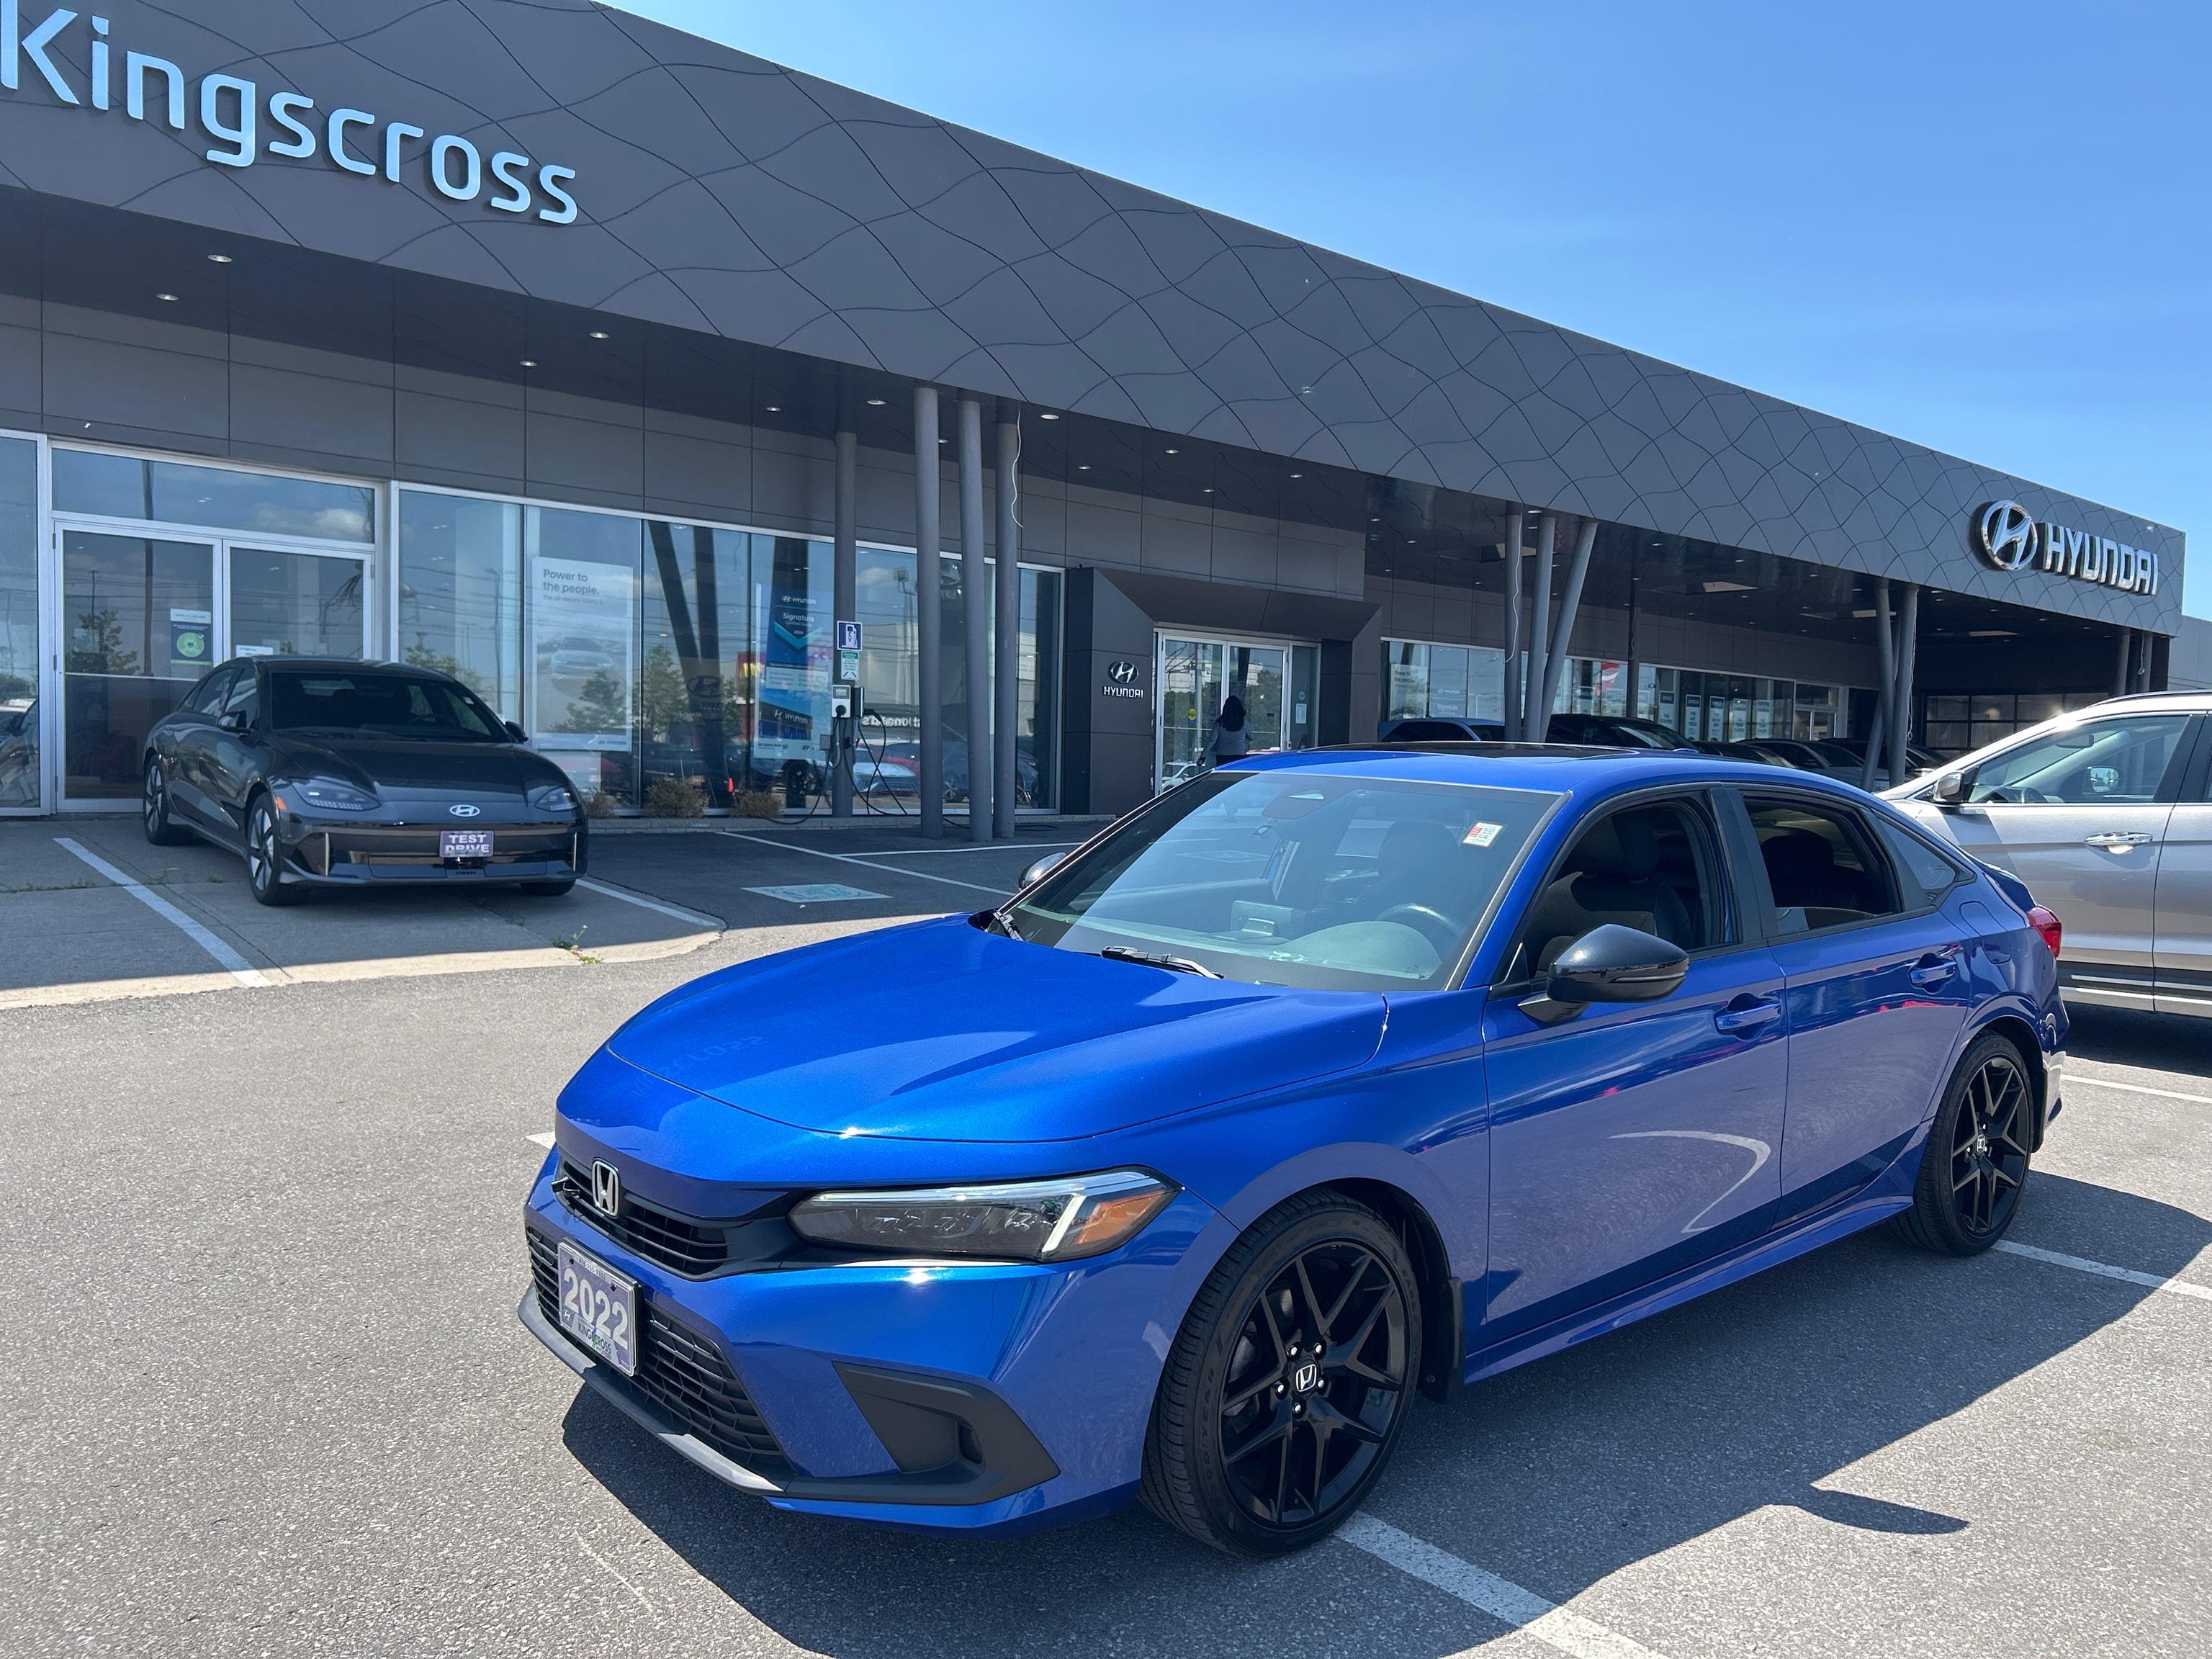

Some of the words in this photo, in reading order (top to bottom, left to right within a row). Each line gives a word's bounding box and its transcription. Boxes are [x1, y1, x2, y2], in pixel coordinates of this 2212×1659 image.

[0, 0, 578, 225] Kingscross
[2044, 522, 2159, 595] HYUNDAI
[544, 569, 575, 580] Power
[577, 573, 588, 582] to
[544, 582, 559, 591] the
[562, 585, 600, 595] people.
[783, 613, 815, 623] Signature
[1104, 686, 1143, 698] HYUNDAI
[449, 835, 487, 844] TEST
[444, 844, 490, 854] DRIVE
[564, 1268, 628, 1350] 2022
